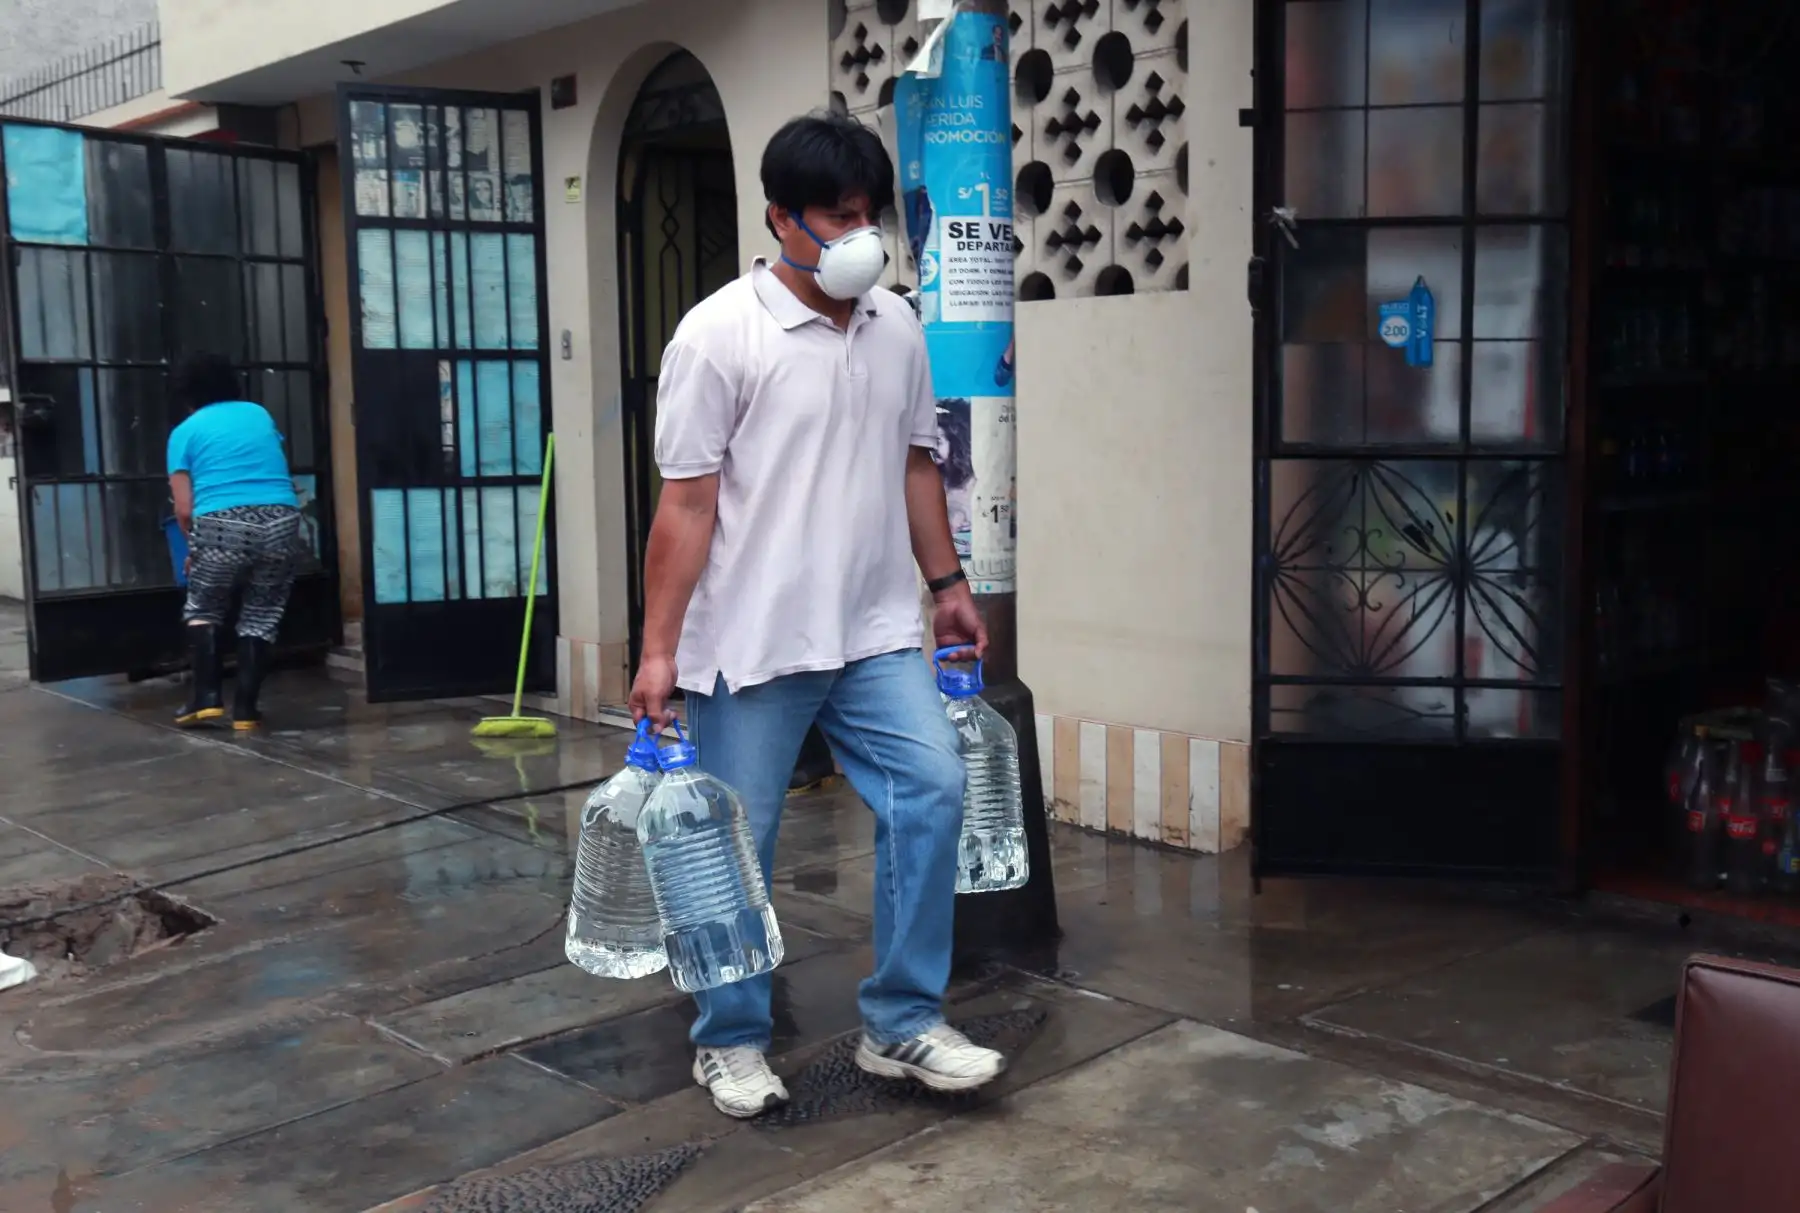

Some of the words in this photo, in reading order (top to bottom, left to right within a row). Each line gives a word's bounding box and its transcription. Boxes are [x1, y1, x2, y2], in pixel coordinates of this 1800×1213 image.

[949, 94, 984, 109] LUIS
[927, 112, 977, 128] ERIDA
[924, 128, 1006, 144] ROMOCIÓN
[949, 222, 981, 240] SE
[956, 241, 1014, 253] DEPARTA
